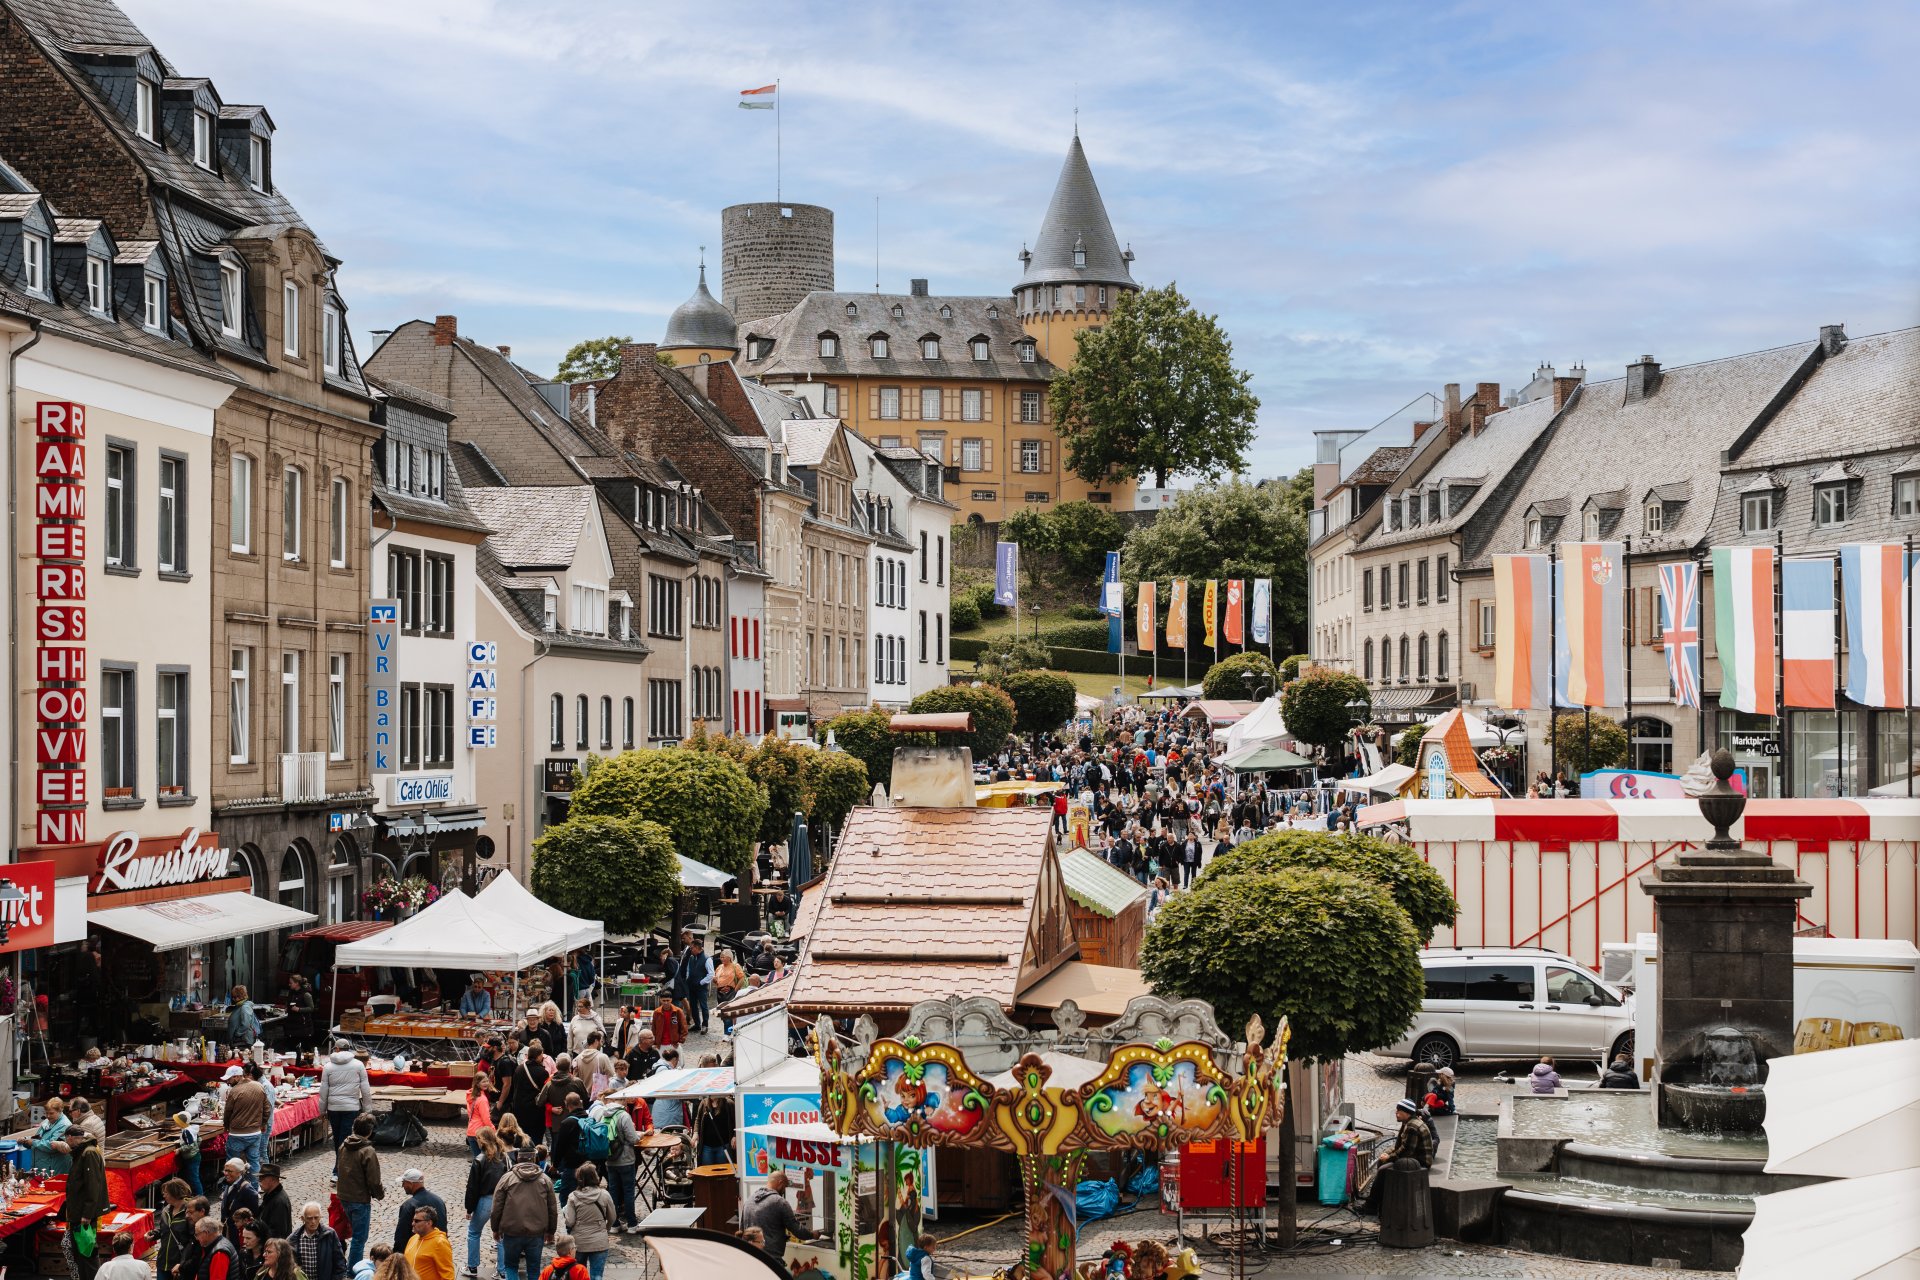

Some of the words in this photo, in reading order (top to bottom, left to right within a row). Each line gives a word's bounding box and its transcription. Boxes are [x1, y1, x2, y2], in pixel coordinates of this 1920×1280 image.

[38, 404, 69, 842] RAMERSHOVEN
[70, 405, 85, 842] RAMERSHOVEN
[376, 634, 390, 673] VR
[470, 644, 486, 745] CAFE
[376, 690, 389, 769] Bank
[1746, 748, 1756, 758] 24
[1764, 743, 1780, 754] C&A
[400, 781, 423, 801] Cafe
[424, 779, 449, 799] Ohlig
[95, 826, 230, 894] Ramershoven
[775, 1136, 842, 1168] KASSE
